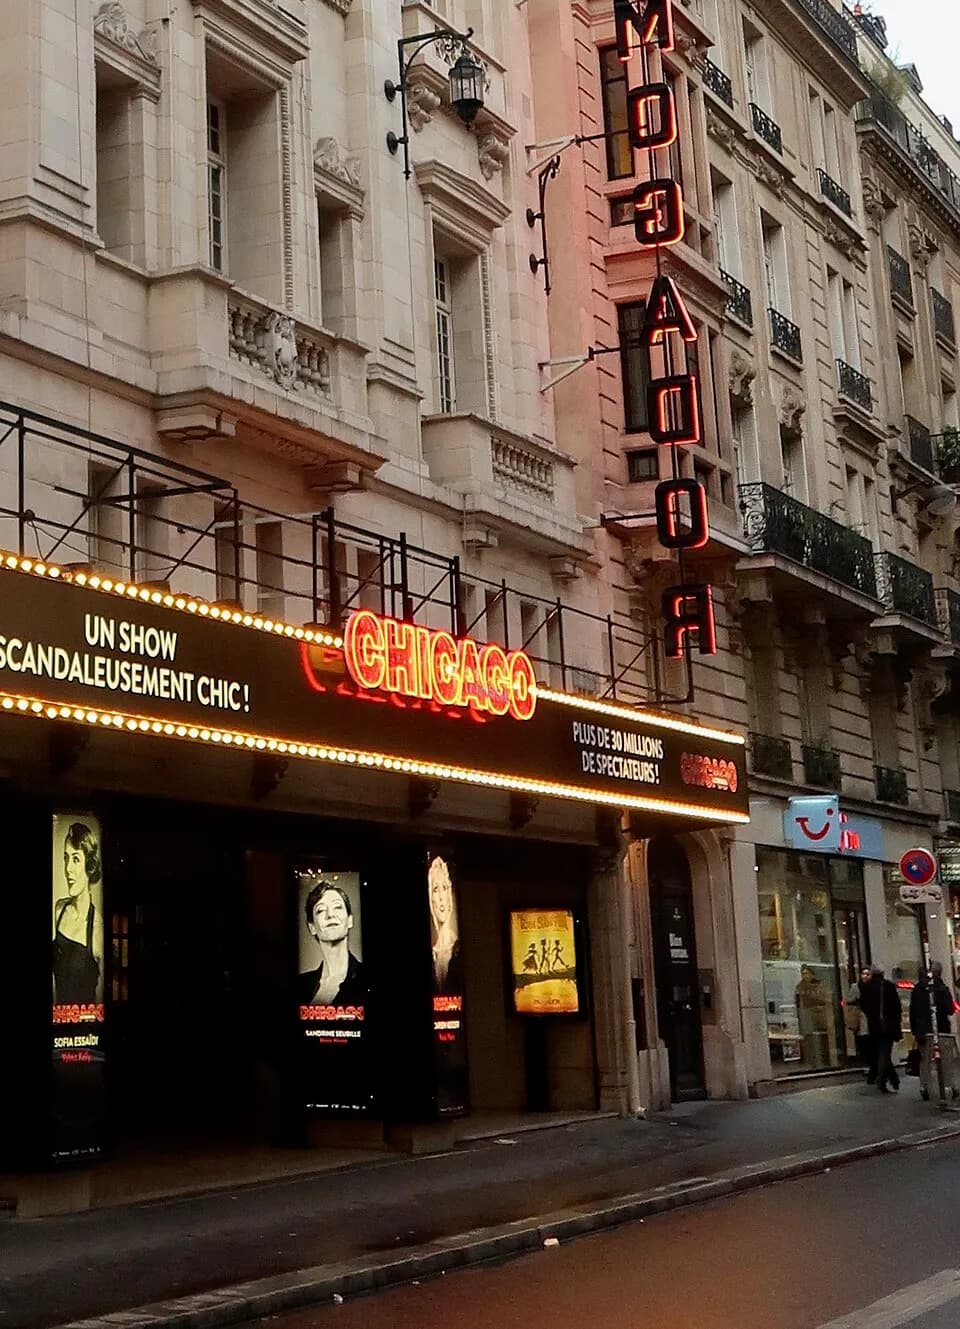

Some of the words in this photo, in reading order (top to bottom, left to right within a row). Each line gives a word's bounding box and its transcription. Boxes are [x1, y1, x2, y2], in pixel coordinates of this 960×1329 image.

[85, 614, 114, 650] UN
[119, 623, 177, 662] SHOW
[344, 609, 537, 721] CHICAGO
[573, 721, 596, 746] PLUS
[597, 726, 610, 749] DE
[611, 729, 622, 751] 30
[623, 732, 664, 759] MILLIONS
[582, 750, 596, 773] DE
[53, 1037, 74, 1048] SOFIA
